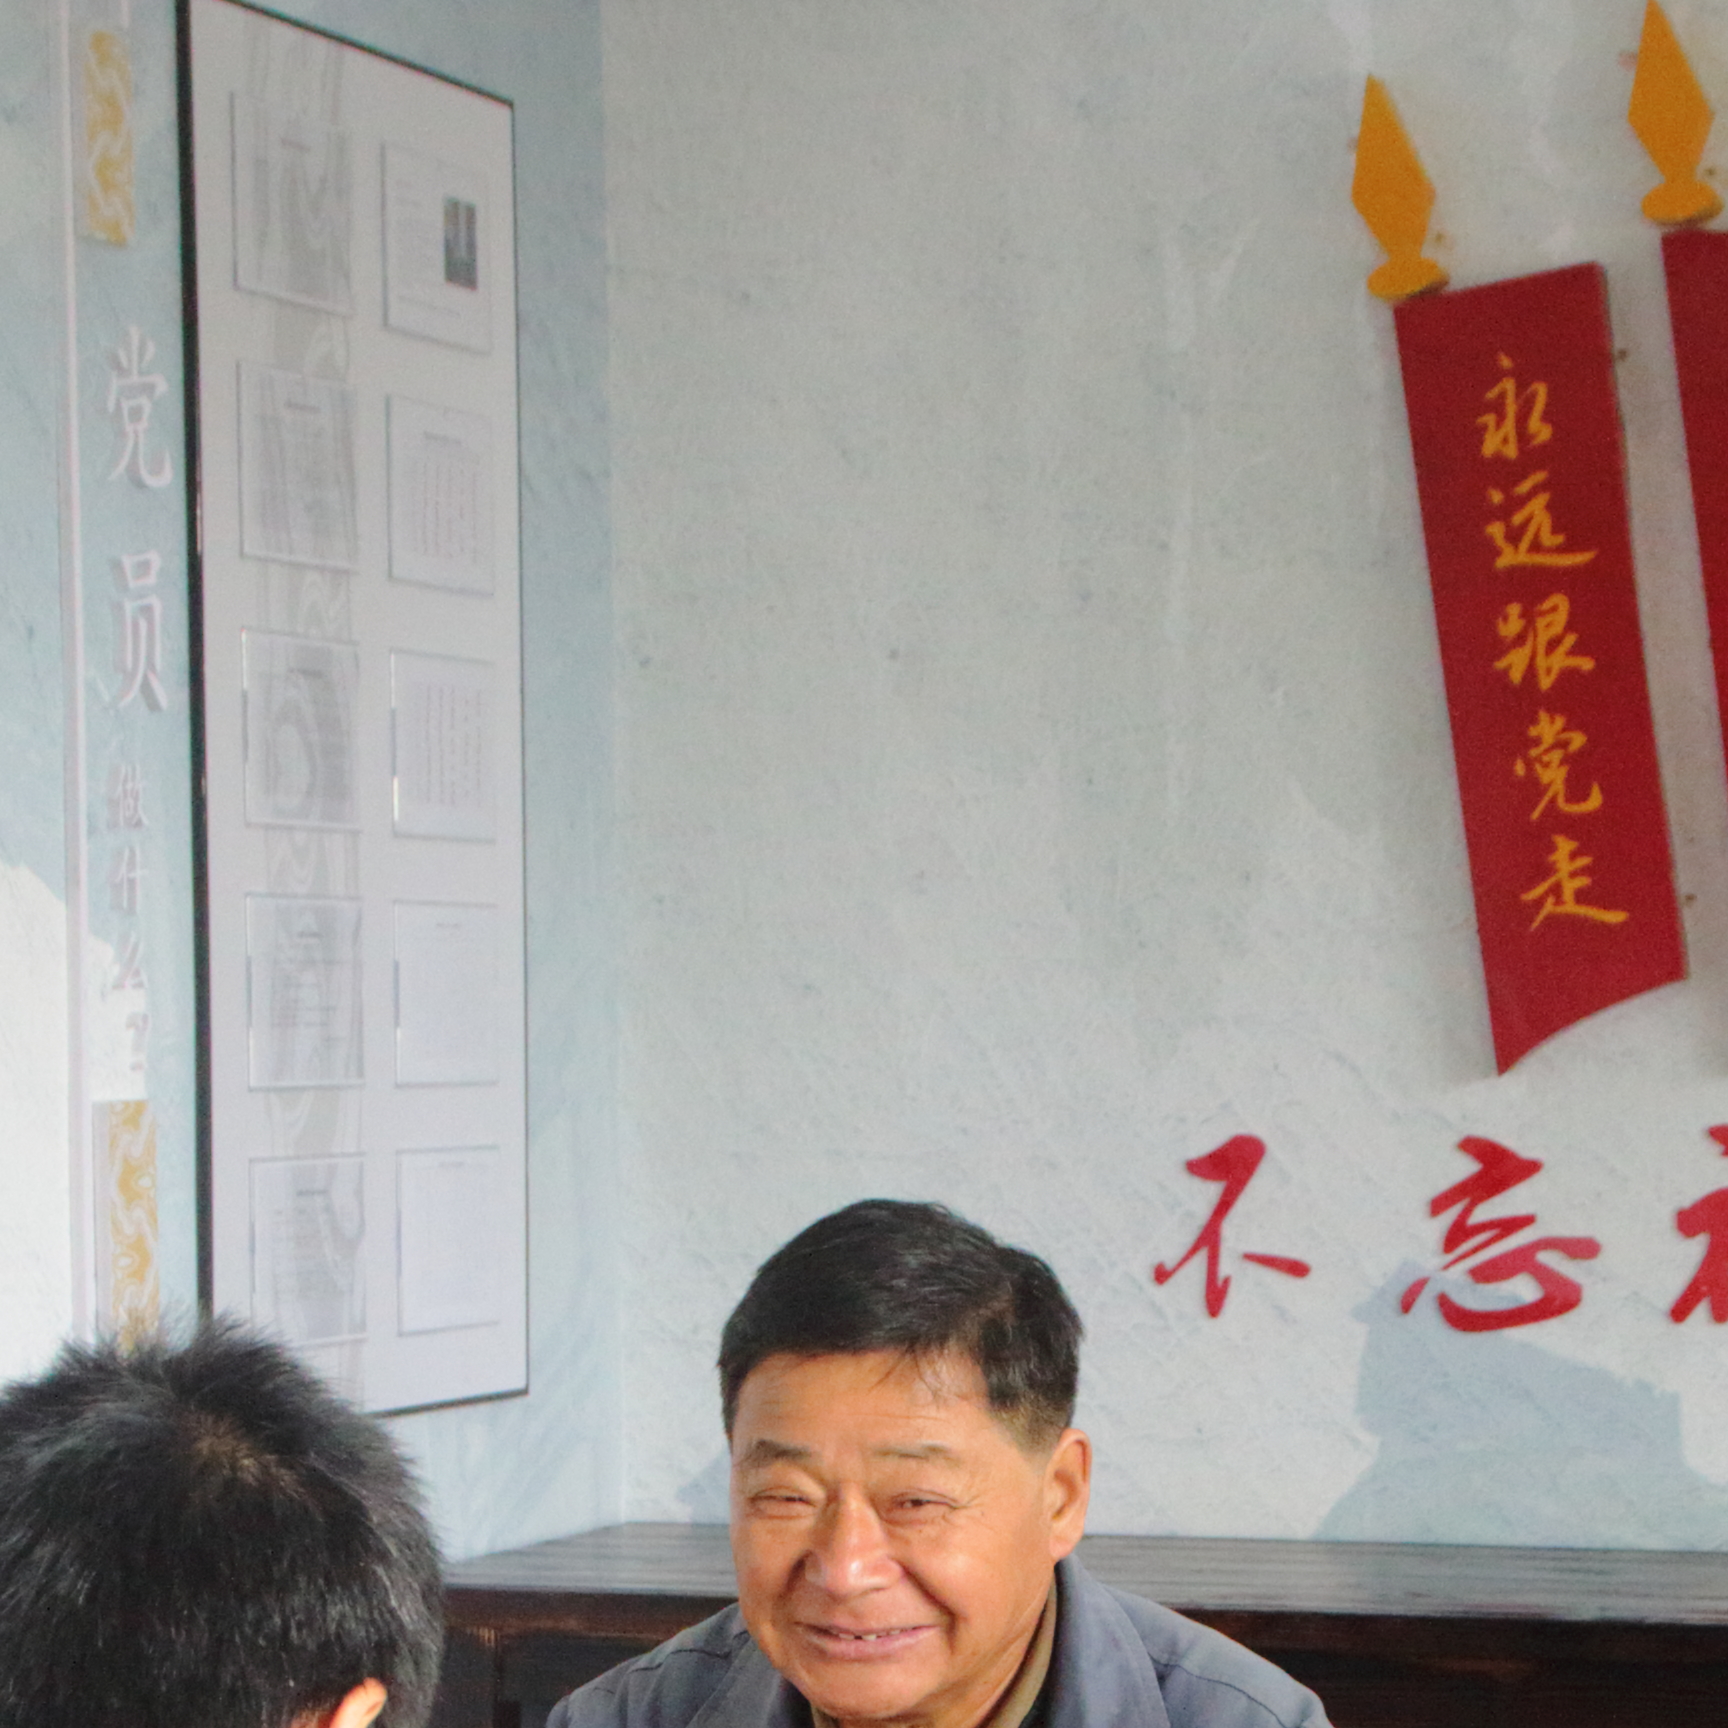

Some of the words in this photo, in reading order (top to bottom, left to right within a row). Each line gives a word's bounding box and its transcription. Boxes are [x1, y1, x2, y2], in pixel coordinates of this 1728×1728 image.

[1475, 352, 1630, 932] 永远跟党走
